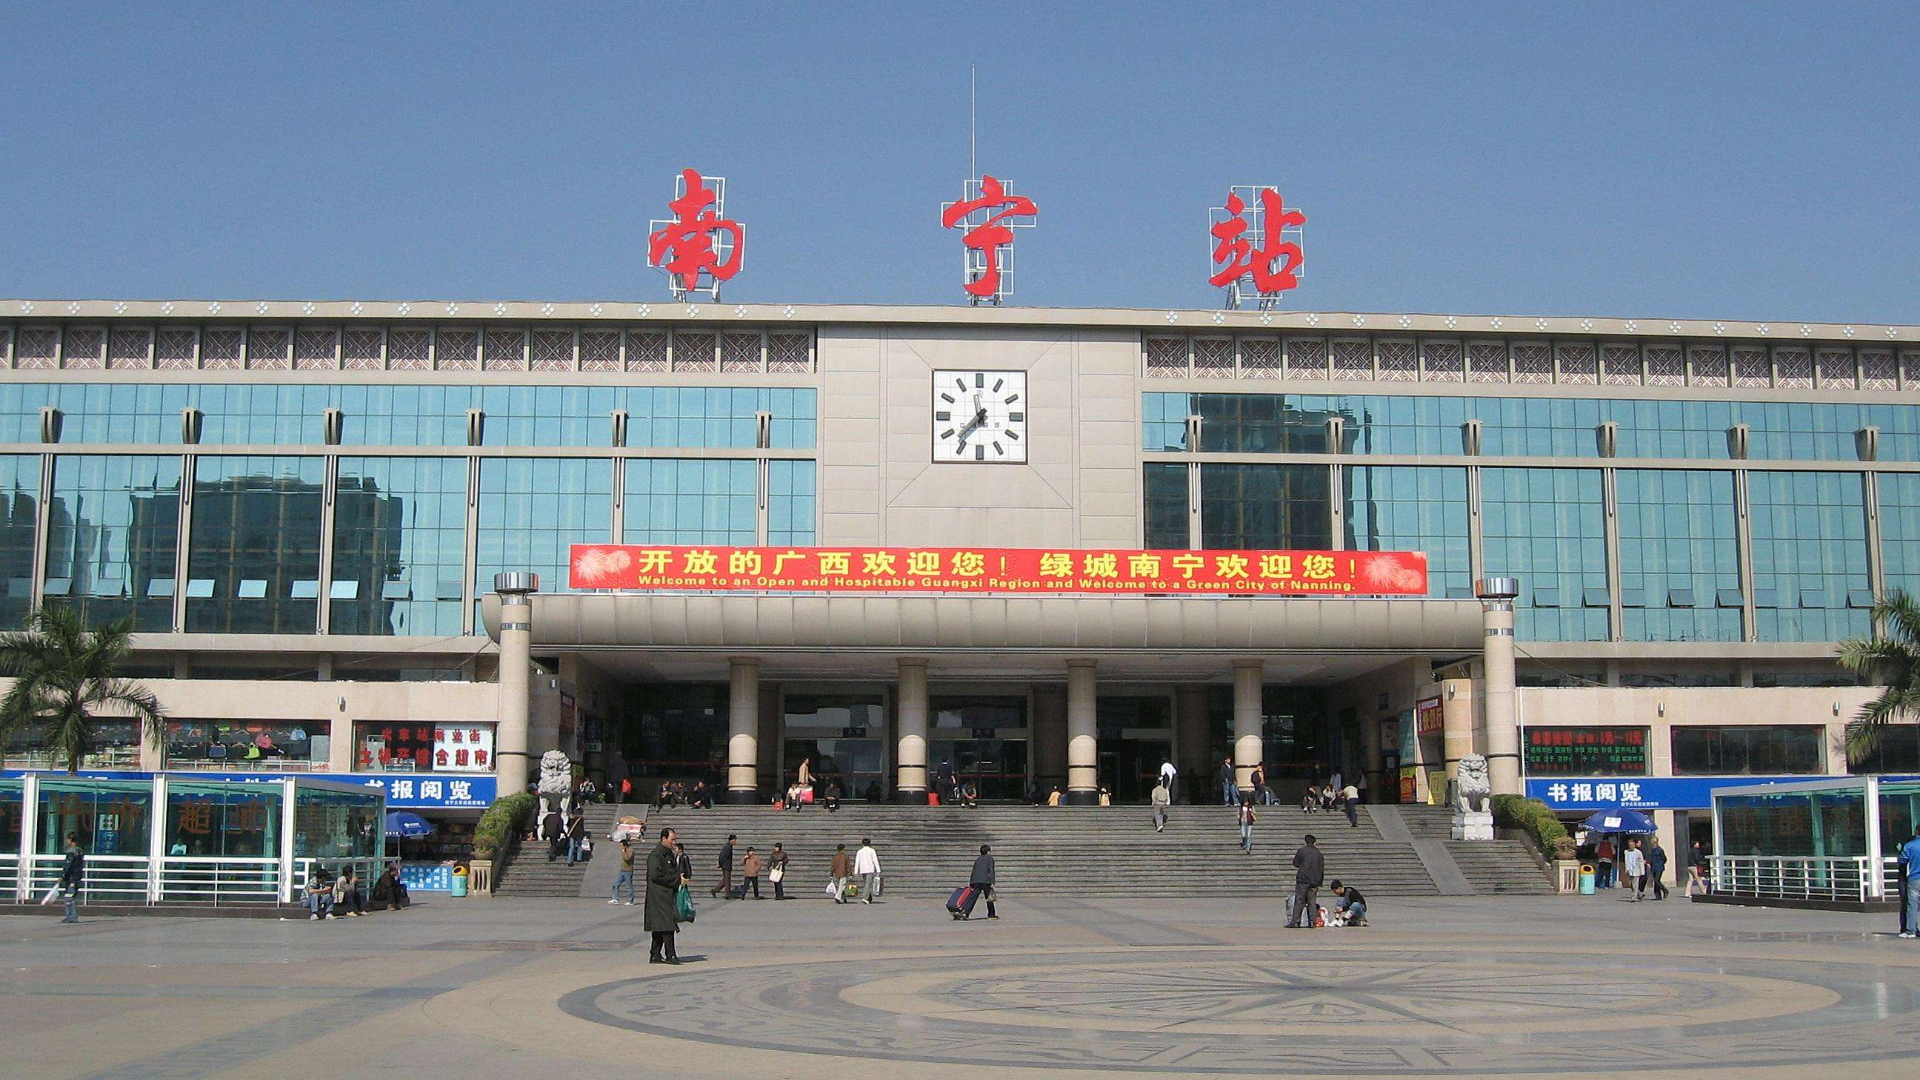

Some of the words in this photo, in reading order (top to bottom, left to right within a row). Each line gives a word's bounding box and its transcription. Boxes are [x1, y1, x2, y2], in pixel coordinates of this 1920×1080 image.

[648, 169, 1307, 296] 南宁站
[638, 549, 1008, 577] 开放的广西欢迎您！
[1039, 552, 1358, 580] 绿城南宁欢迎您！
[638, 574, 706, 586] Welcome
[712, 575, 728, 586] to
[734, 576, 751, 586] an
[757, 575, 796, 588] Open
[802, 575, 829, 587] and
[834, 576, 916, 589] Hospitable
[922, 577, 984, 589] Guangxi
[989, 577, 1041, 590] Region
[1046, 577, 1073, 589] and
[1079, 578, 1146, 589] Welcome
[1152, 579, 1167, 589] to
[1172, 580, 1181, 589] a
[1186, 579, 1230, 590] Green
[1235, 579, 1265, 591] City
[1271, 579, 1285, 590] of
[1291, 580, 1356, 592] Nanning.
[1547, 782, 1642, 802] 书报阅览
